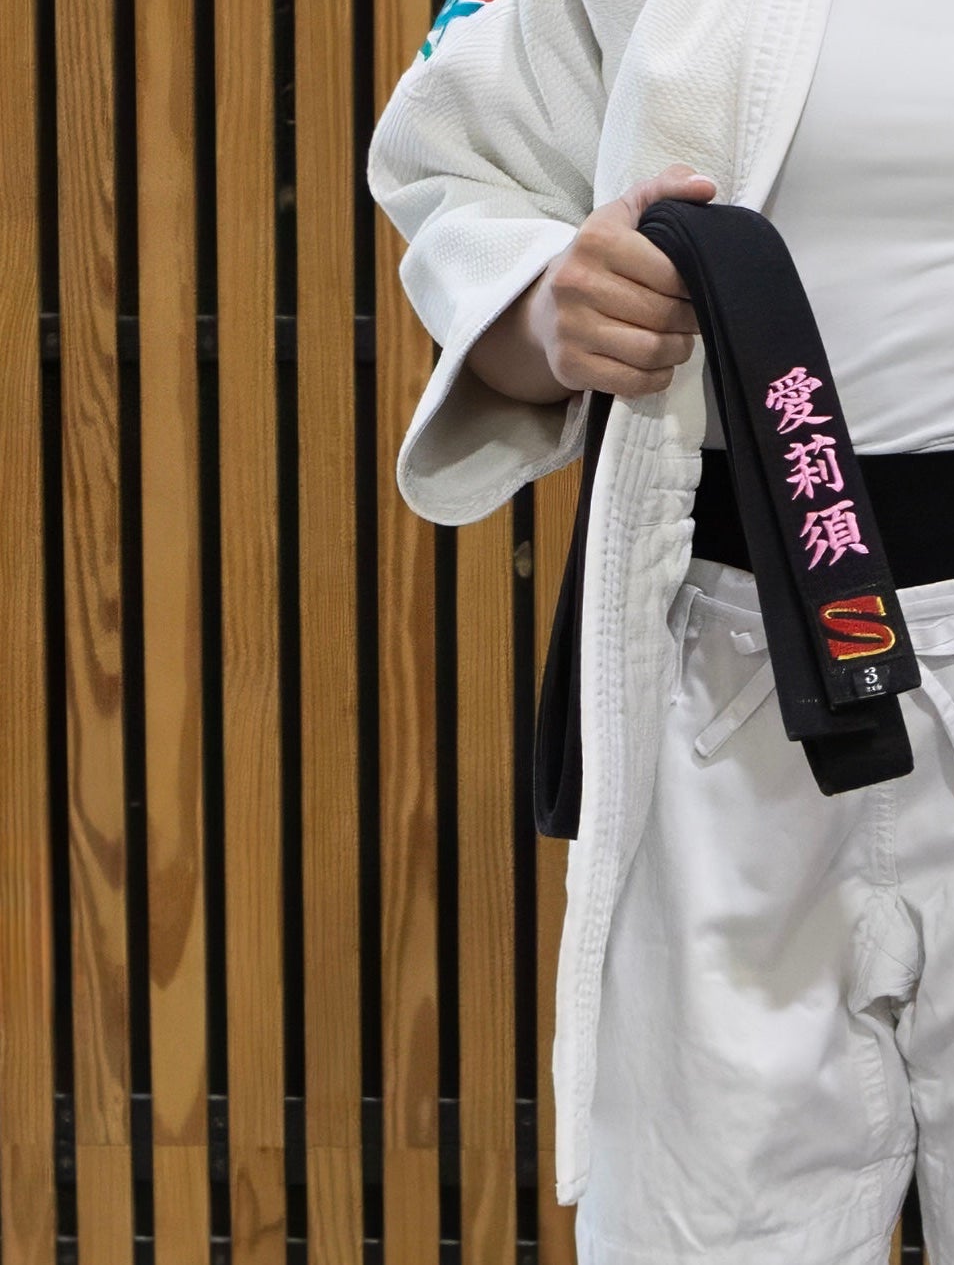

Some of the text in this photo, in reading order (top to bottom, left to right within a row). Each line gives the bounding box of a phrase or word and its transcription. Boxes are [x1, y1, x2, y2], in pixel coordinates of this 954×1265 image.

[765, 366, 870, 571] 愛莉須
[863, 666, 879, 684] 3
